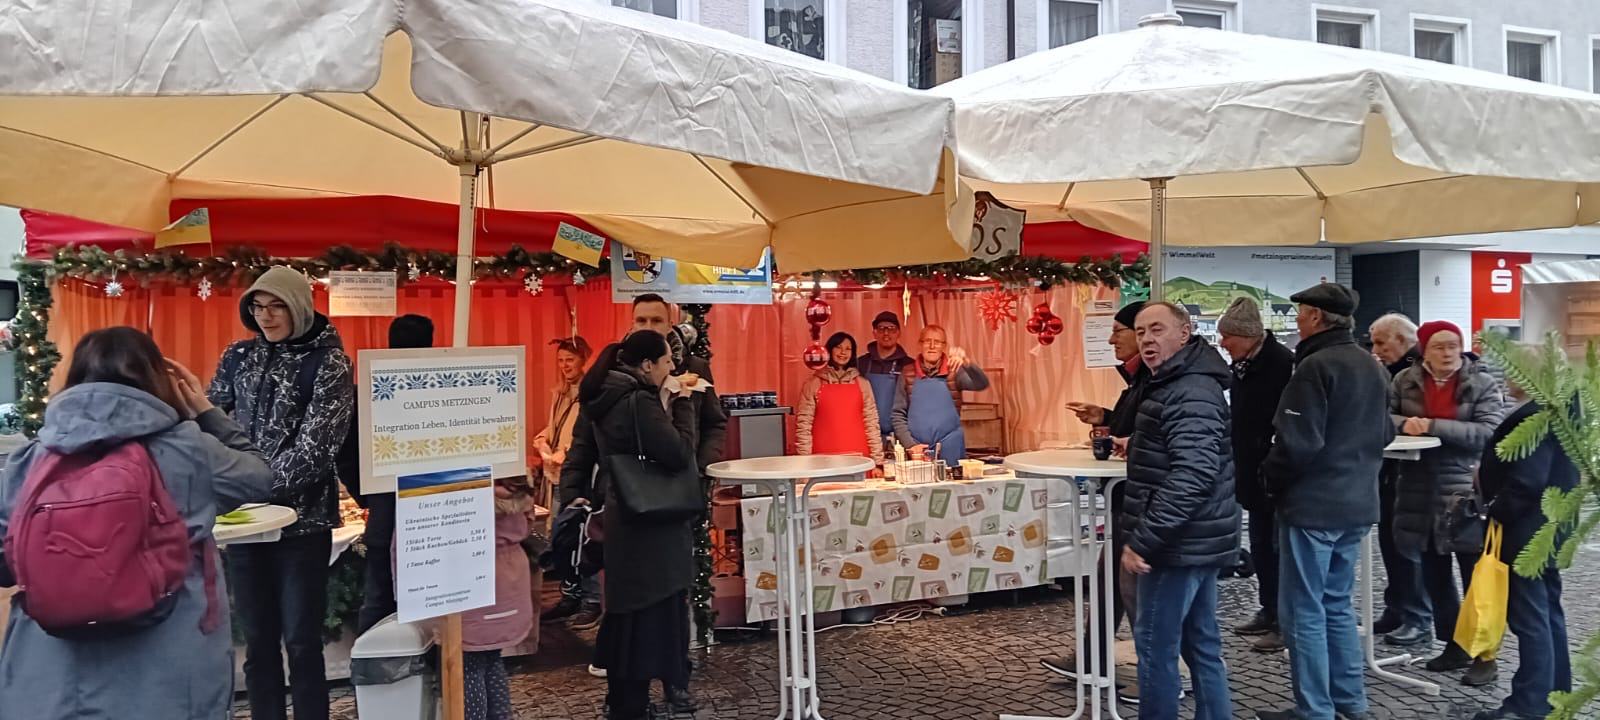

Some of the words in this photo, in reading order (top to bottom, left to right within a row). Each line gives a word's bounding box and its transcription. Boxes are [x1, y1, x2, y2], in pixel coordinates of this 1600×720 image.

[403, 399, 440, 410] CAMPUS
[441, 396, 491, 408] METZINGEN
[374, 421, 420, 434] Integration
[421, 419, 448, 430] Leben,
[449, 416, 481, 428] Identität
[482, 415, 516, 425] bewahren
[418, 501, 441, 510] Unser
[442, 496, 474, 507] Angebot
